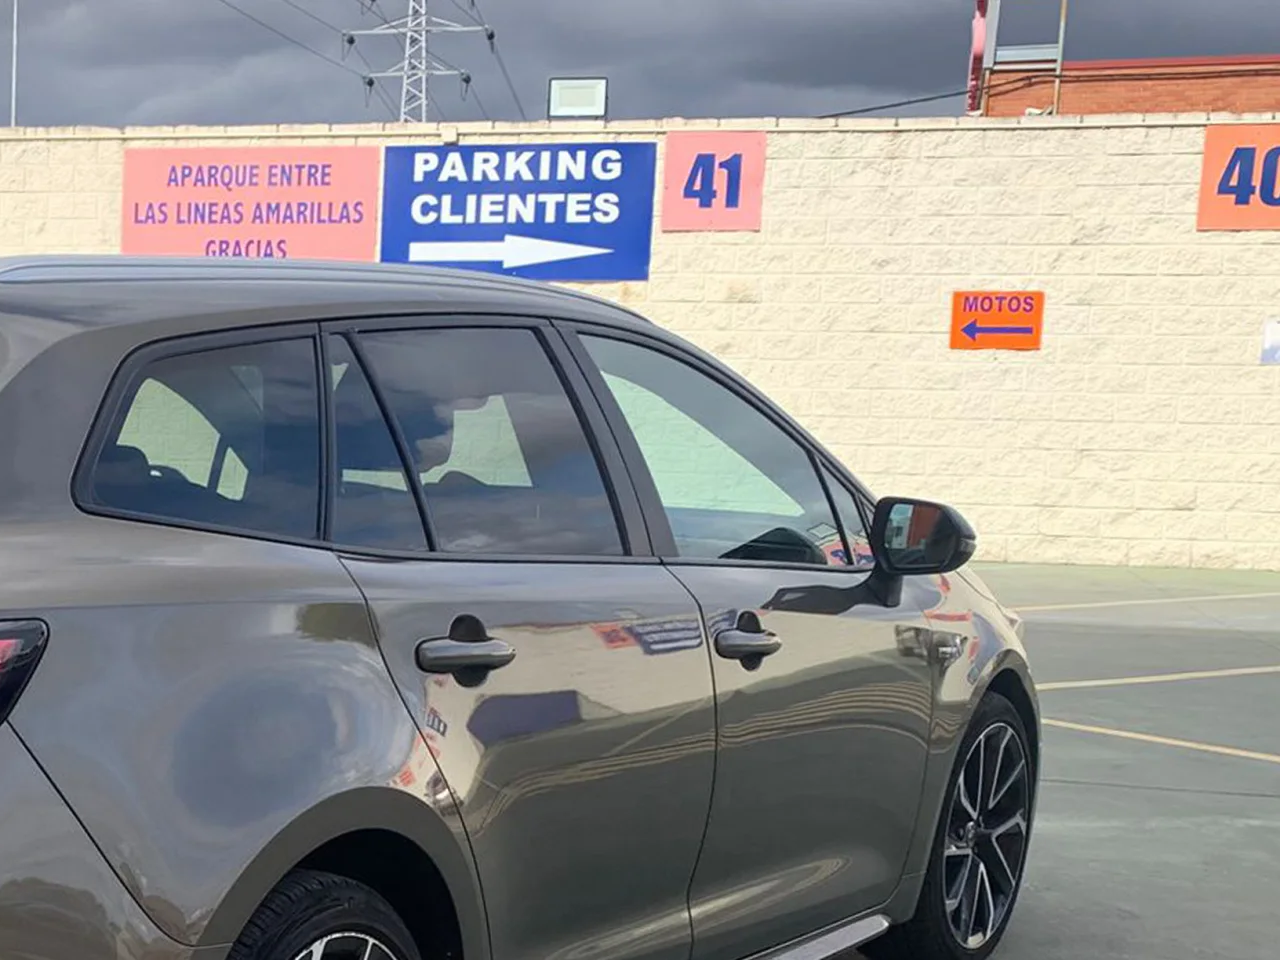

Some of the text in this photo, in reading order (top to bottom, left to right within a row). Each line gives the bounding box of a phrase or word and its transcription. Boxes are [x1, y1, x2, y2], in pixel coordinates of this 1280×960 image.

[166, 163, 332, 192] APARQUE ENTRE
[412, 148, 623, 183] PARKING
[682, 152, 743, 210] 41
[133, 200, 365, 225] LAS LINEAS AMARILLAS
[410, 191, 621, 225] CLIENTES
[204, 239, 288, 258] GRACIAS
[963, 295, 1035, 313] MOTOS
